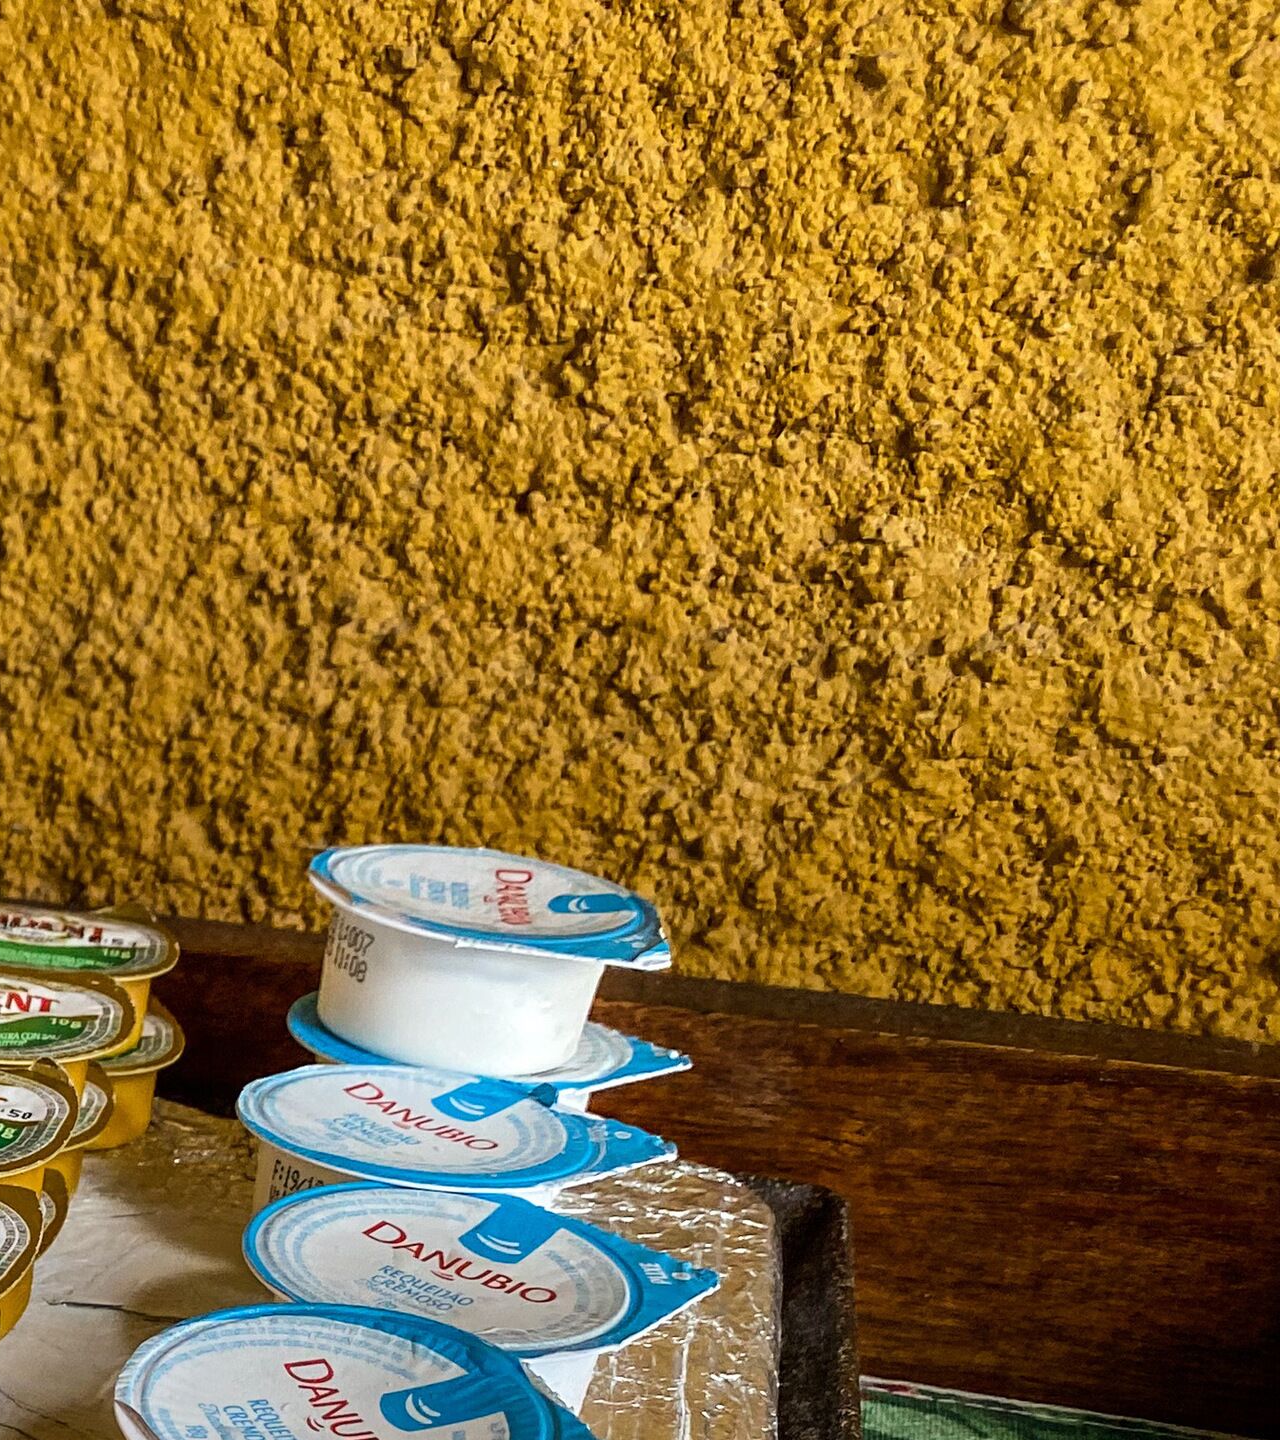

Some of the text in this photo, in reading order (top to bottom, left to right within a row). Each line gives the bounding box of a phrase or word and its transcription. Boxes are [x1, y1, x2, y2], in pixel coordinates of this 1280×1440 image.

[342, 1081, 499, 1151] DANUBIO
[361, 1219, 558, 1304] DANUBIO
[377, 1264, 474, 1307] REQUEIJÃO
[370, 1273, 454, 1312] CREMOSO
